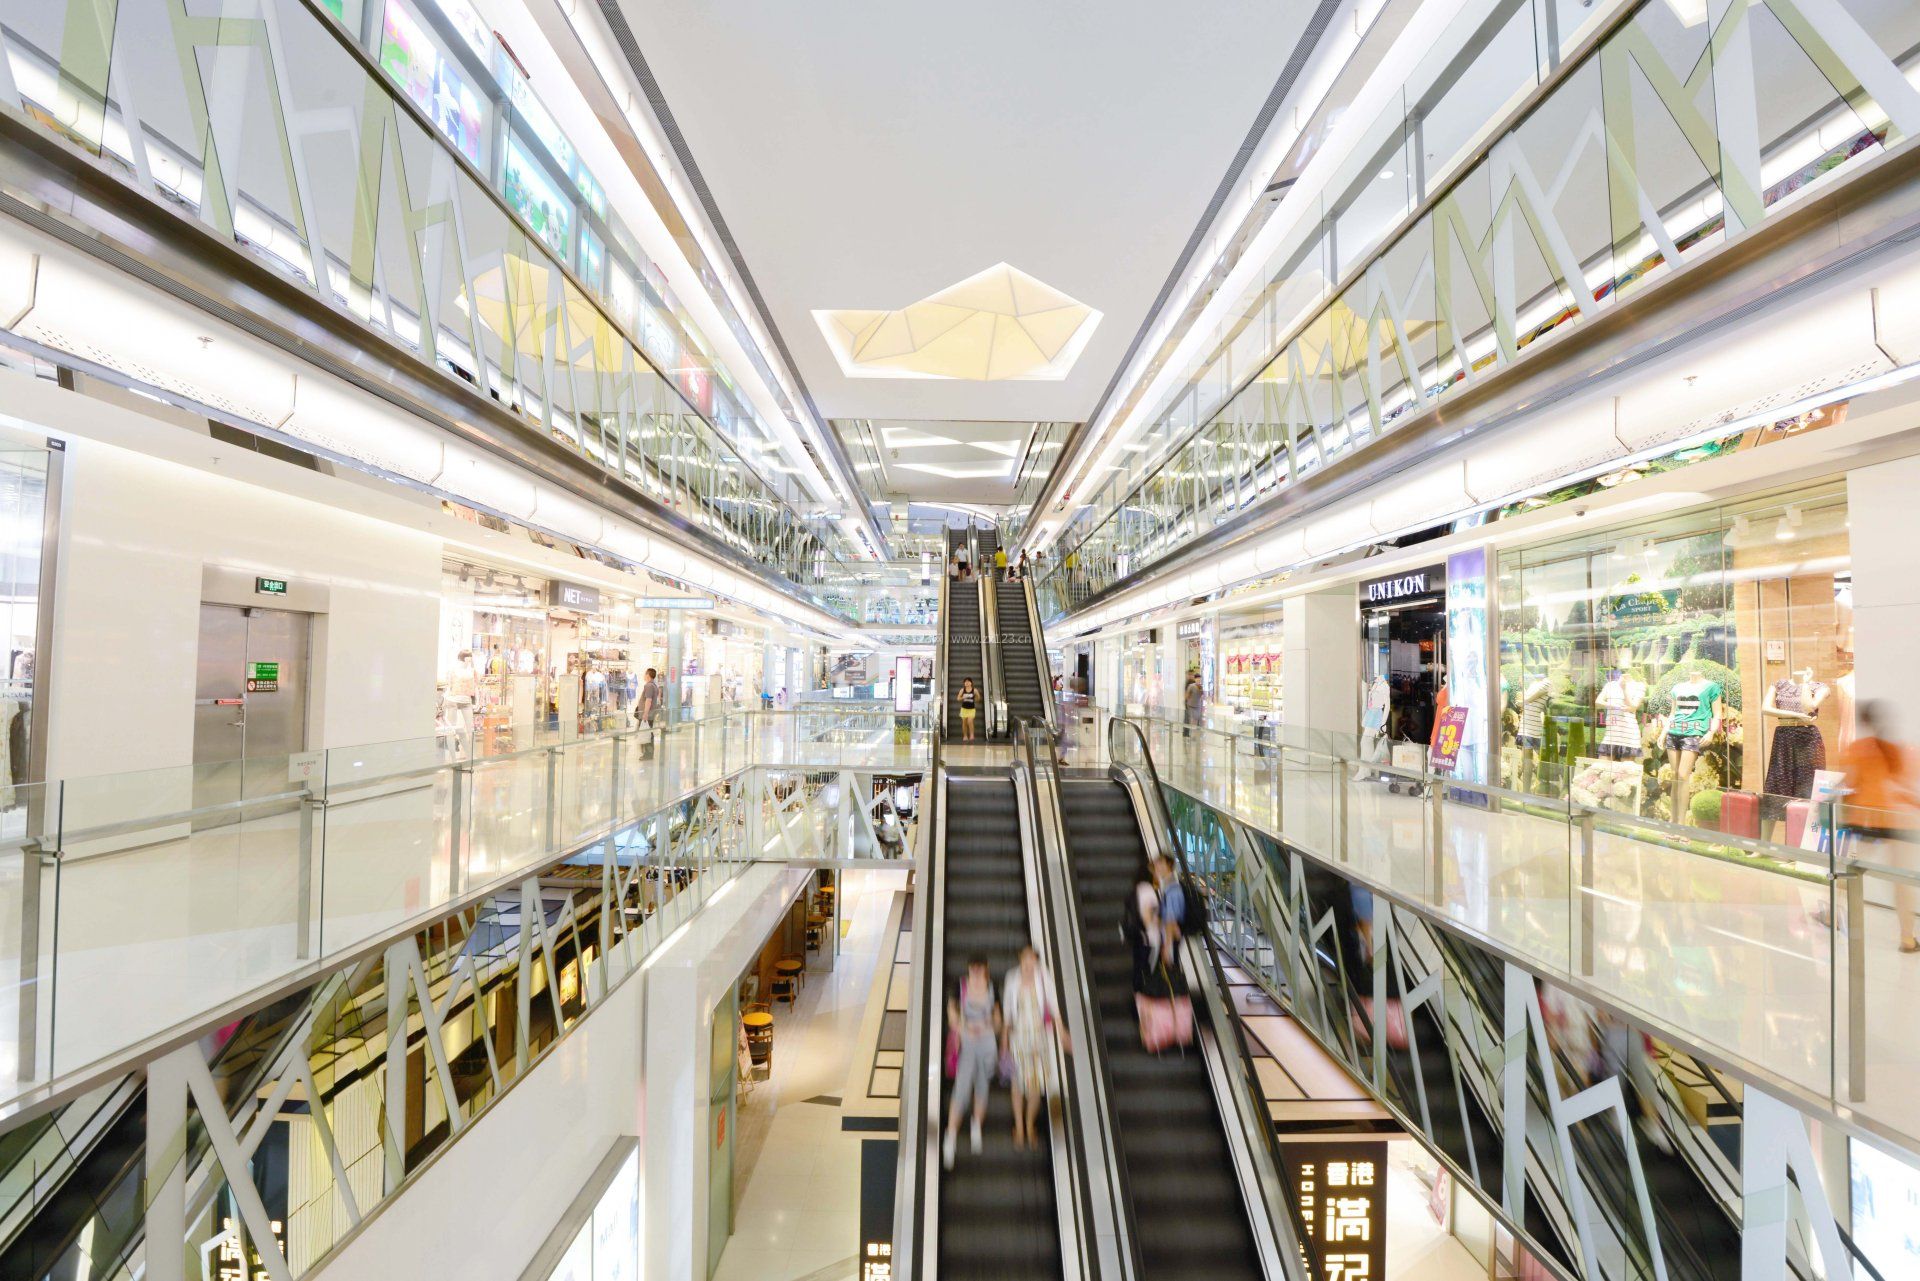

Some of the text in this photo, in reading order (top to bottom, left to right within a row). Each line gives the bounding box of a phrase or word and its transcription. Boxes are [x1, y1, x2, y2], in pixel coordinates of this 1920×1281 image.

[263, 580, 283, 590] 安全出口
[1368, 573, 1426, 602] UNIKON
[563, 587, 582, 605] NET
[1327, 1161, 1374, 1186] 香港
